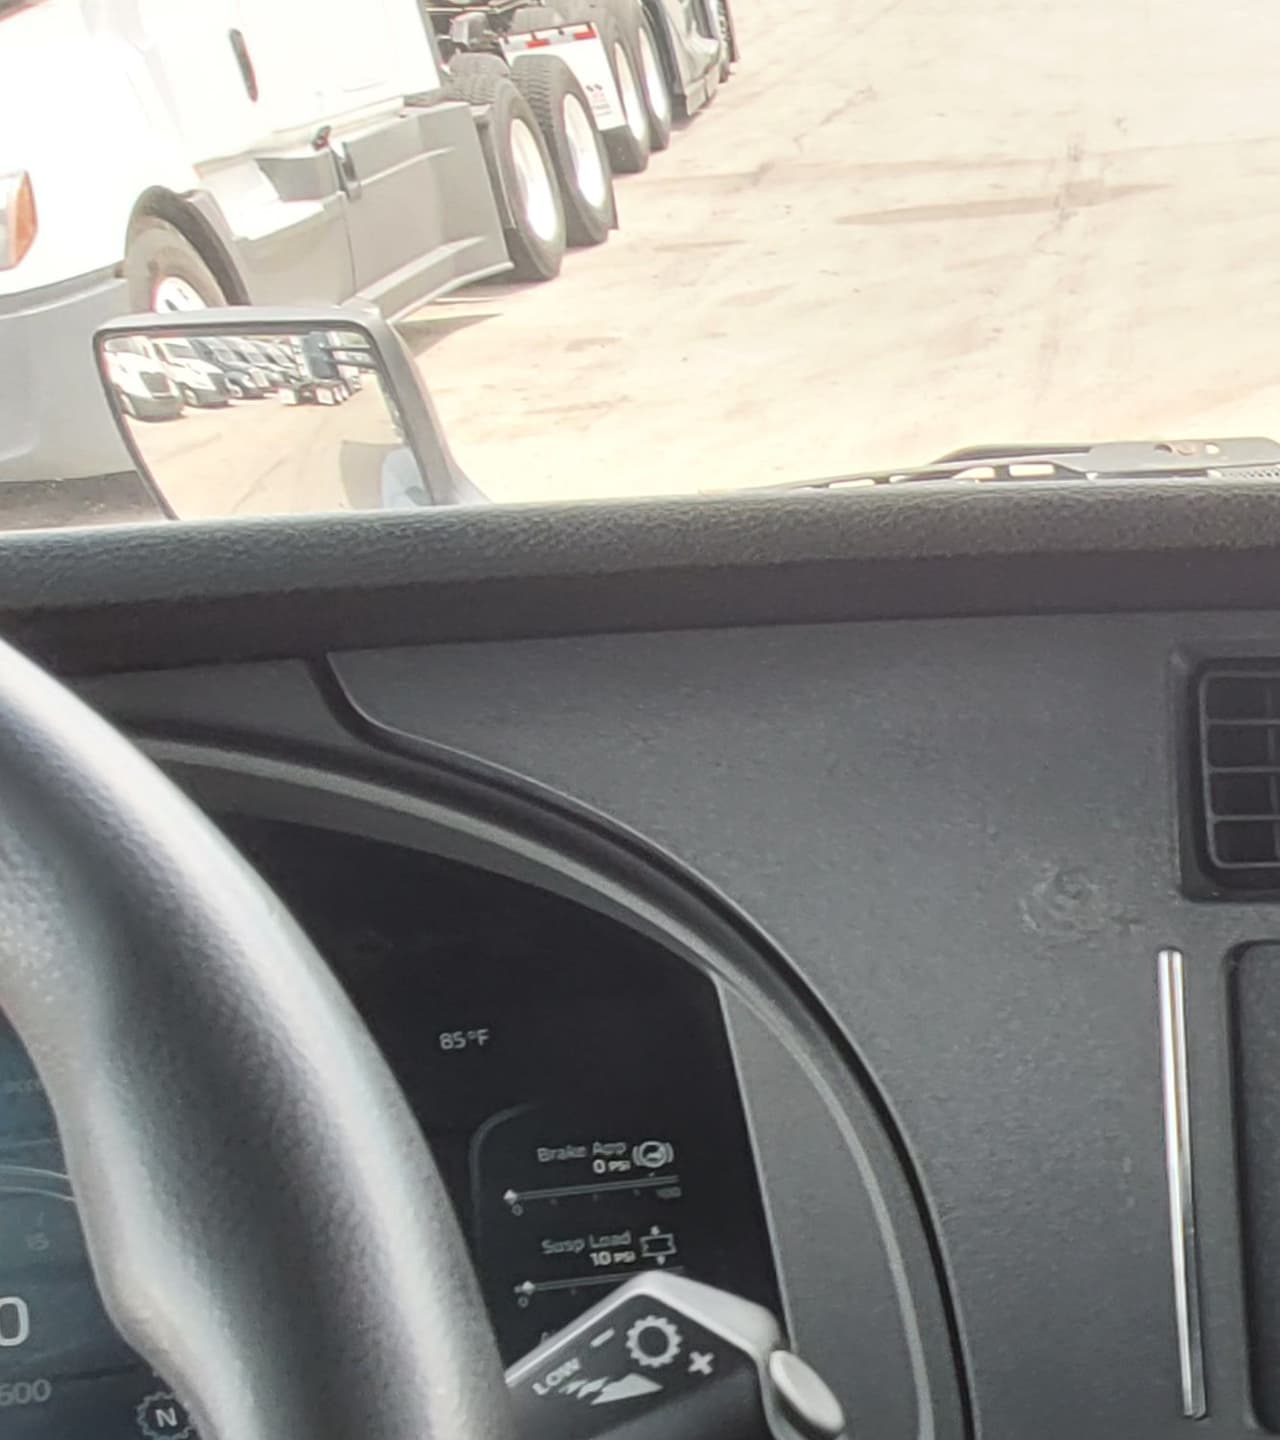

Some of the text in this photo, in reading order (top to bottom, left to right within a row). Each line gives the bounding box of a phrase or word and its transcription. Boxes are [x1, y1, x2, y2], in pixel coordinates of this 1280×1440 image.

[536, 1141, 627, 1162] Brake App
[592, 1159, 631, 1174] 0 PSI
[589, 1230, 632, 1248] Load
[590, 1250, 636, 1267] 10 PSI
[531, 1356, 583, 1397] LOW
[154, 1406, 179, 1428] N
